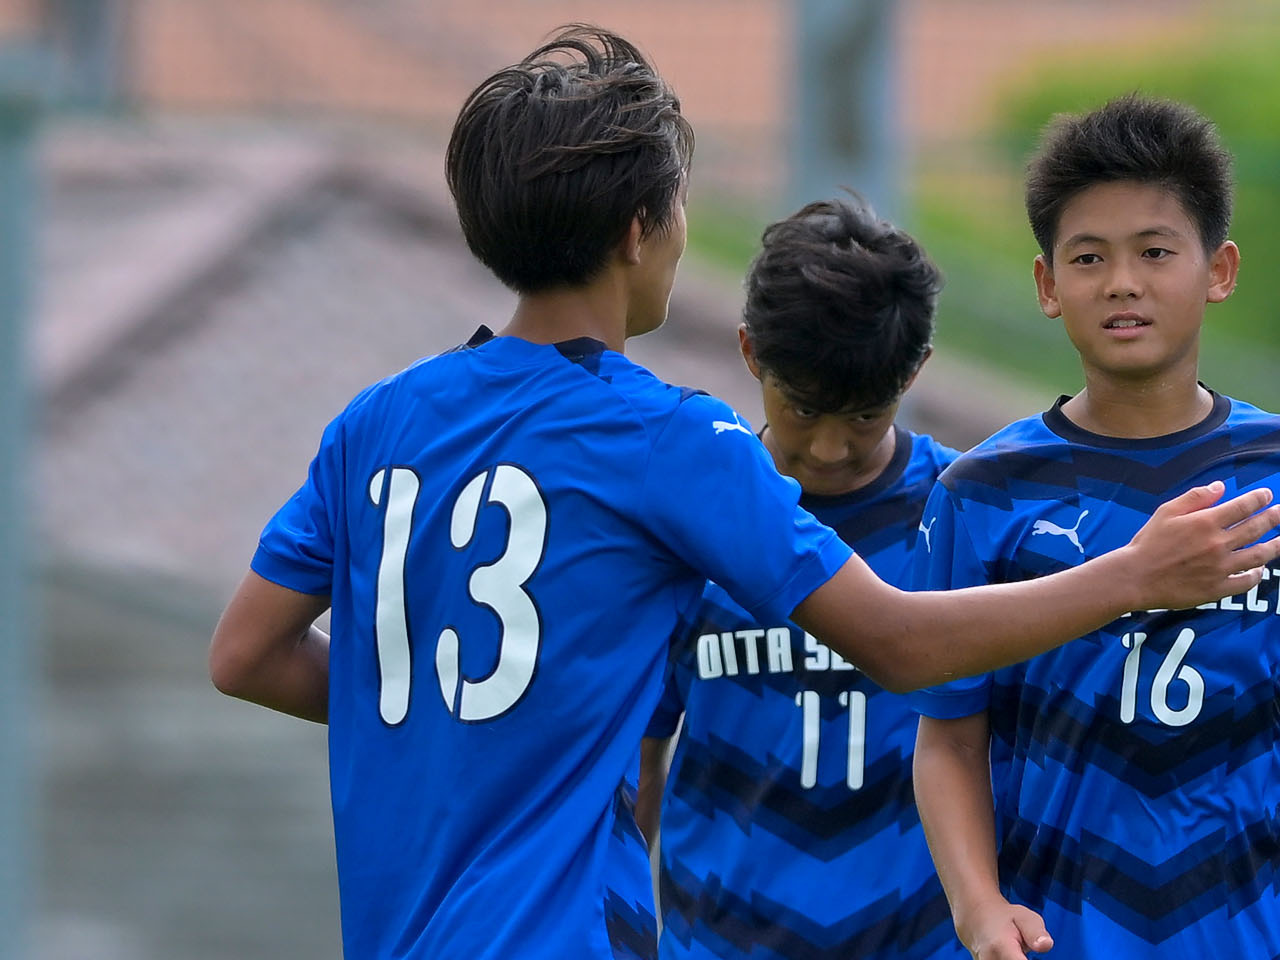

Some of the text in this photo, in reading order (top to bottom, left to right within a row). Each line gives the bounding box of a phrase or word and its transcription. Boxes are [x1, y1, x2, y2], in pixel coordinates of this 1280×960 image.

[369, 465, 547, 725] 13
[697, 626, 794, 680] OITA
[1120, 627, 1205, 727] 16
[795, 690, 867, 790] 11
